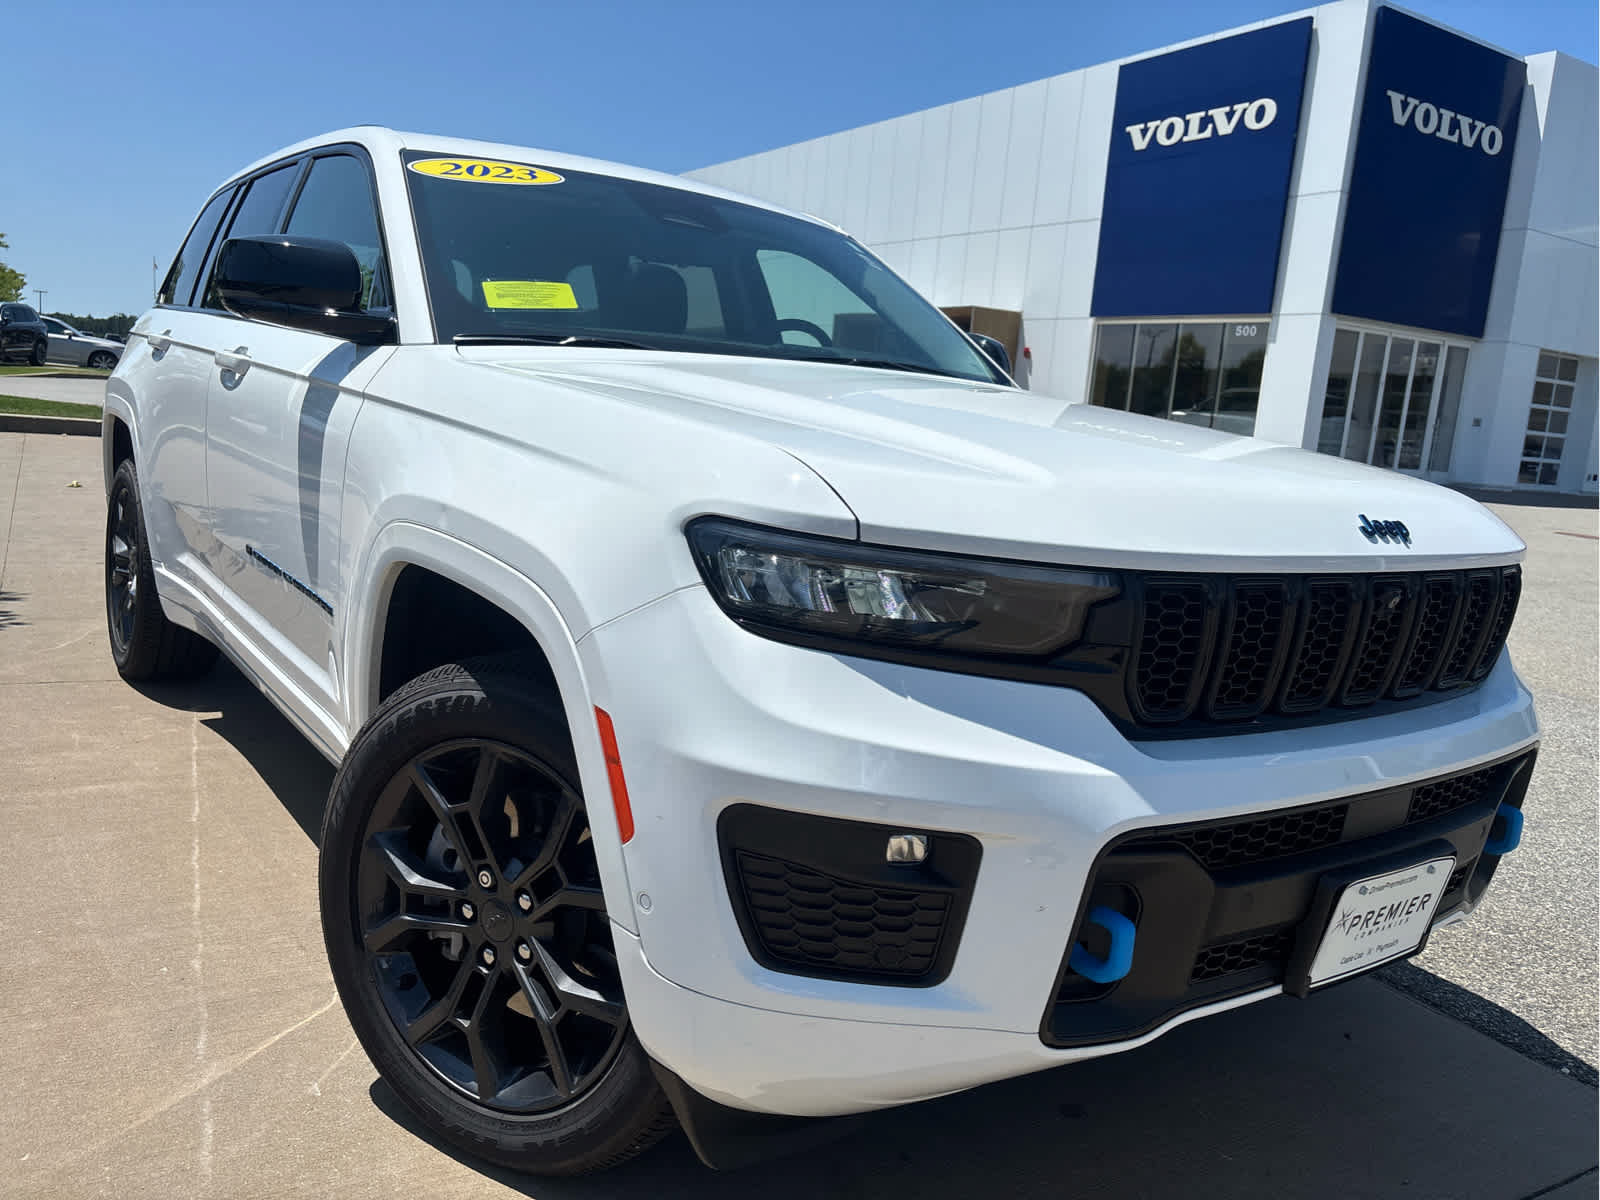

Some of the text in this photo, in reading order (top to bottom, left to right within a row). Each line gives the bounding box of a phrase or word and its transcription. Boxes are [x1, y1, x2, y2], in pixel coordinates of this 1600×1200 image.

[1125, 98, 1277, 151] VOLVO
[1386, 89, 1503, 155] VOLVO
[440, 162, 539, 181] 2023
[1235, 325, 1257, 337] 500
[1358, 513, 1410, 550] Jeep
[1345, 893, 1432, 936] PREMIER
[1353, 917, 1410, 941] COMPANIES
